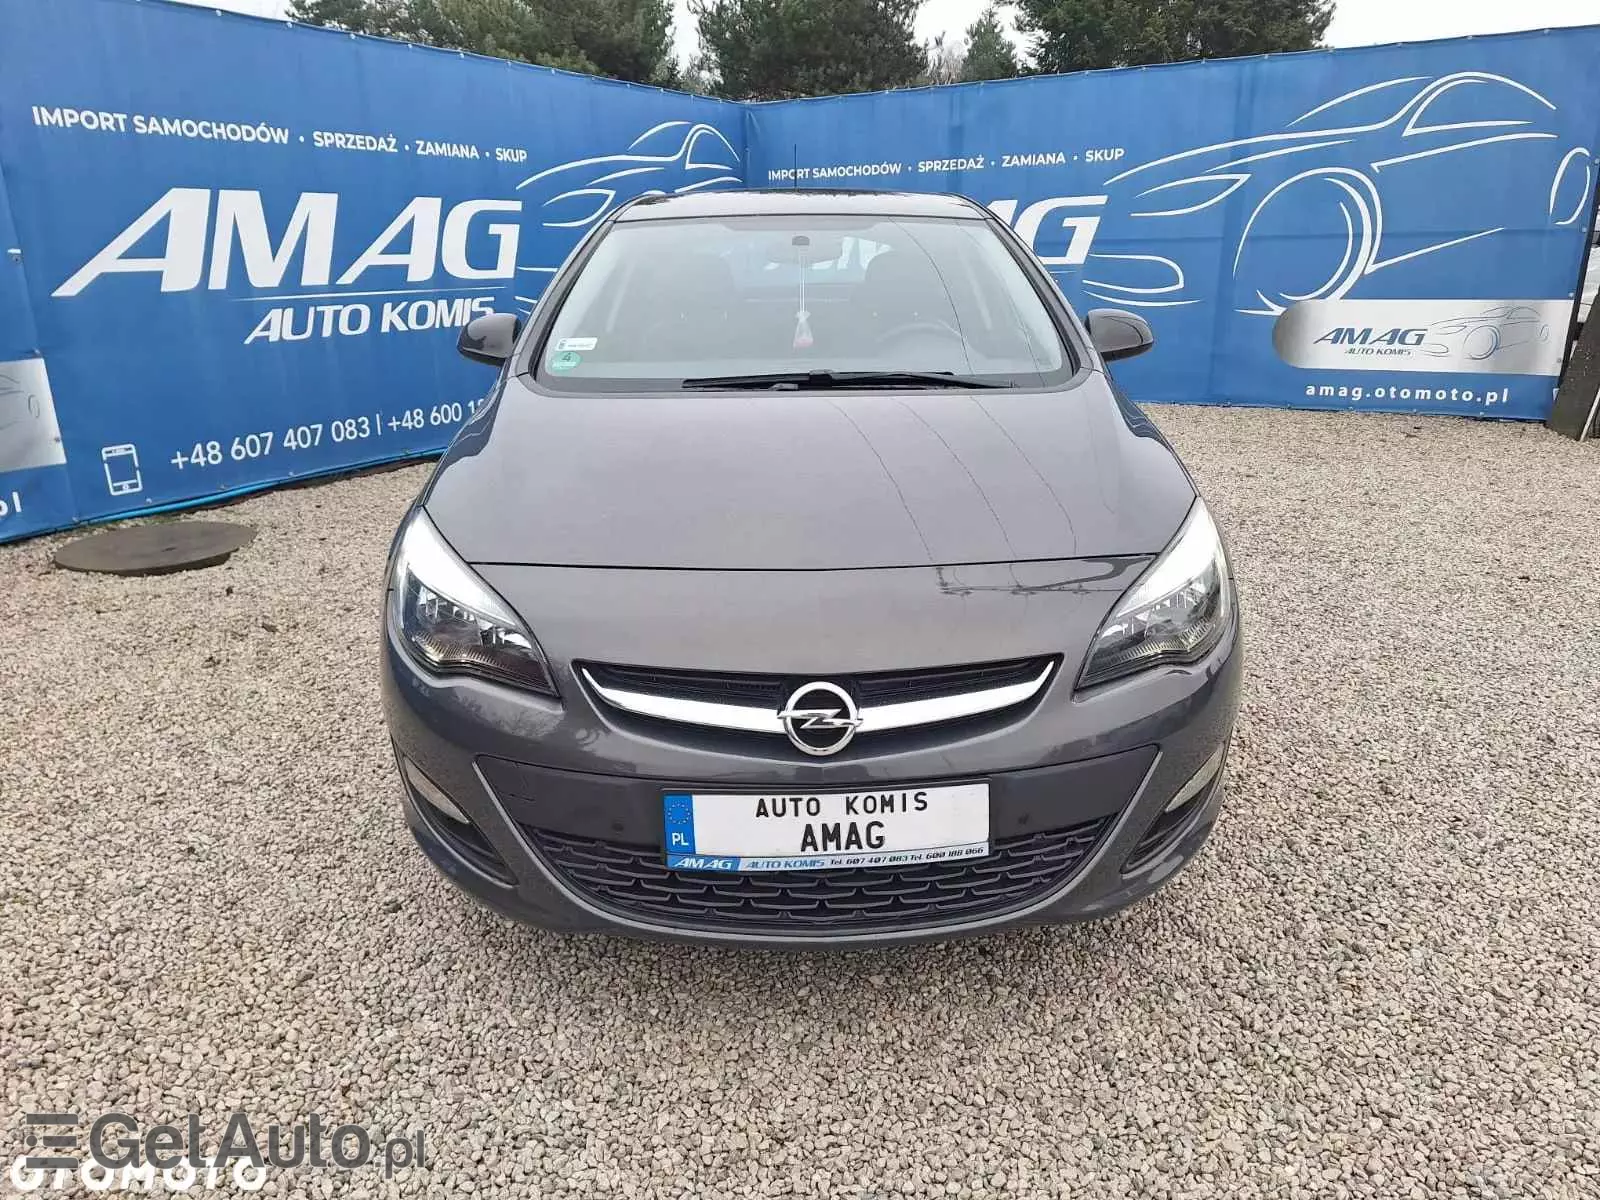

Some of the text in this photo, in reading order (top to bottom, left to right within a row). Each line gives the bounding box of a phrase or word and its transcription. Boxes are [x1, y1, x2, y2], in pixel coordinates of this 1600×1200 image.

[32, 105, 528, 163] IMPORT SAMOCHODÓW SPRZEDAŻ ZAMIANA SKUP
[768, 147, 1125, 181] IMPORT SAMOCHODÓW SPRZEDAŻ ZAMIANA SKUP
[244, 296, 495, 344] AUTO KOMIS
[1312, 327, 1429, 346] AMAG
[1345, 347, 1374, 356] AUTO
[1305, 384, 1510, 404] amag.otomoto.pl
[171, 440, 223, 470] +48
[230, 431, 274, 461] 607
[283, 423, 323, 451] 407
[331, 416, 371, 443] 083
[387, 408, 425, 432] +48
[430, 402, 463, 426] 600
[755, 791, 929, 818] AUTO KOMIS
[671, 832, 689, 847] PL
[800, 821, 886, 852] AMAG
[746, 859, 782, 869] AUTO
[783, 858, 825, 869] KOMIS
